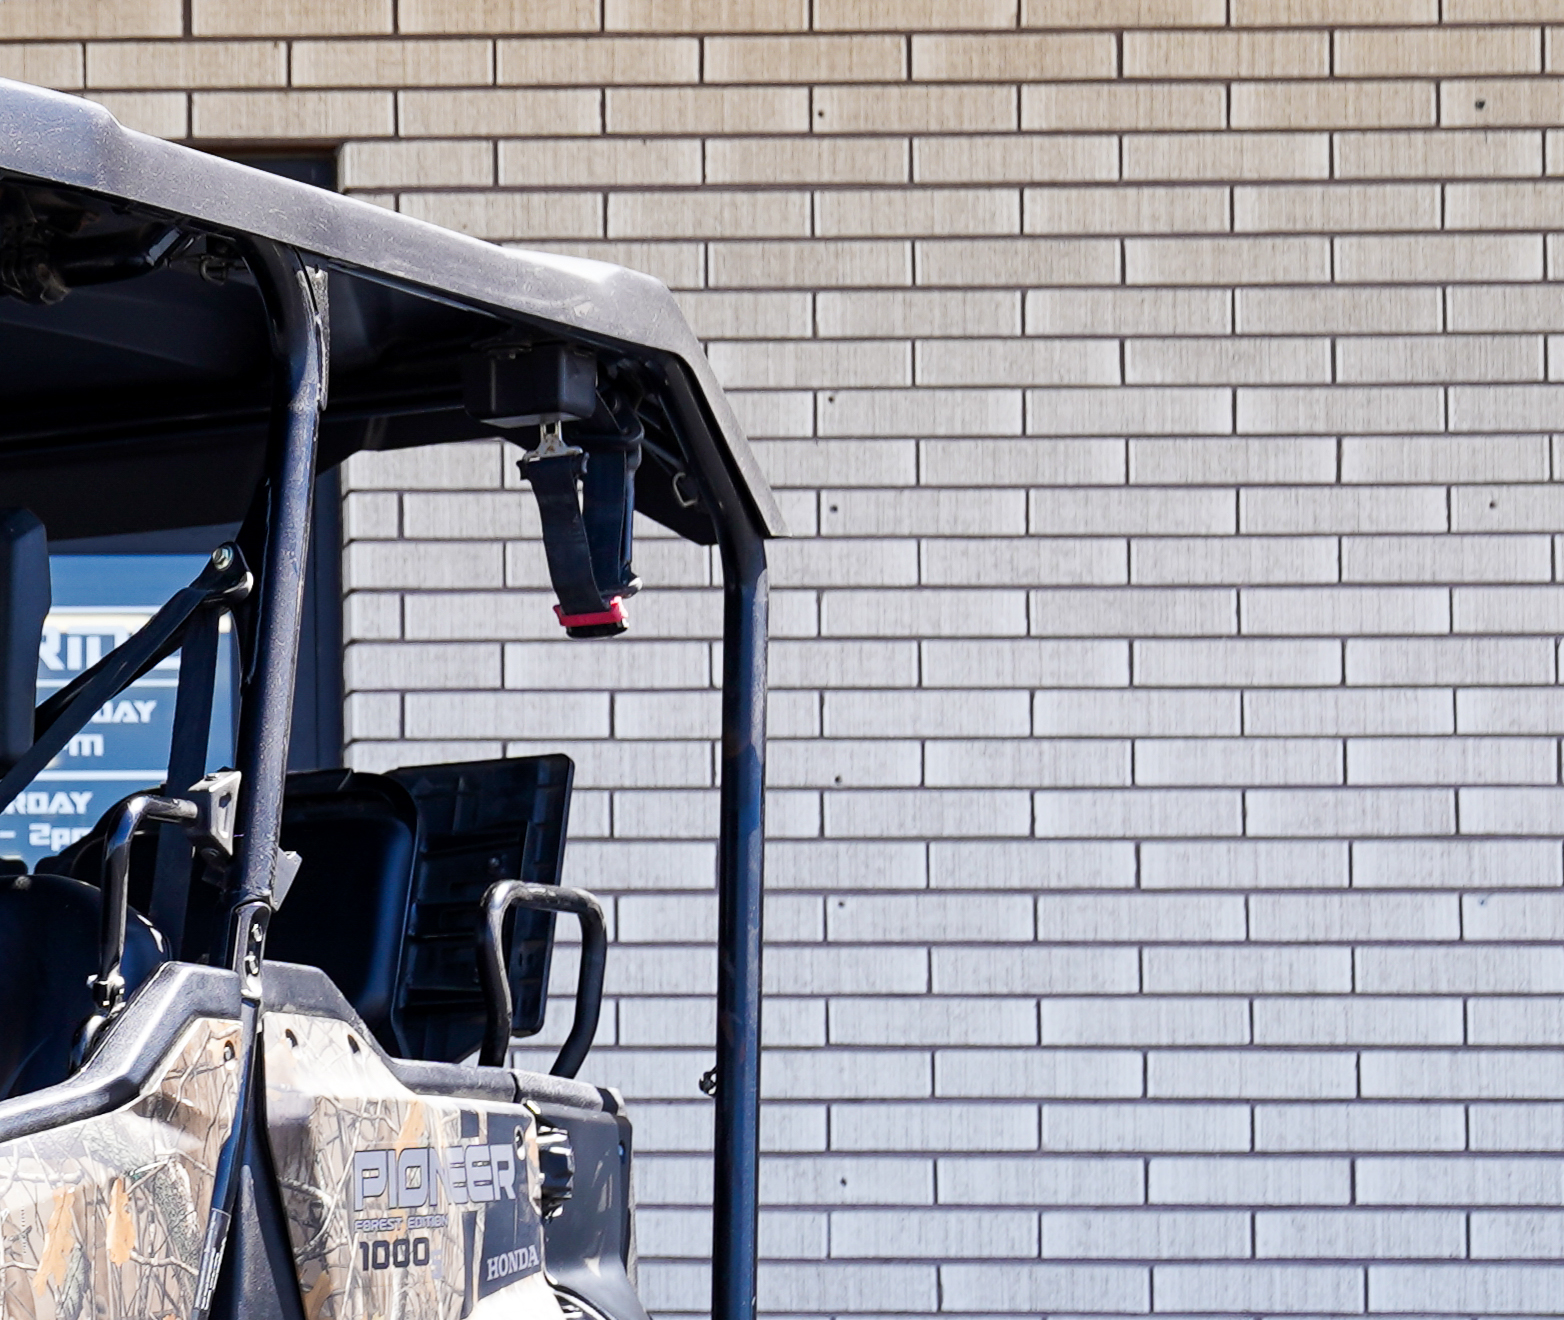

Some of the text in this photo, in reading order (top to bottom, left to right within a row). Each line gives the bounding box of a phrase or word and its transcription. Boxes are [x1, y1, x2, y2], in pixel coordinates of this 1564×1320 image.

[354, 1144, 516, 1211] PIONEER
[354, 1214, 448, 1232] FOREST EDITION
[487, 1245, 539, 1281] HONDA
